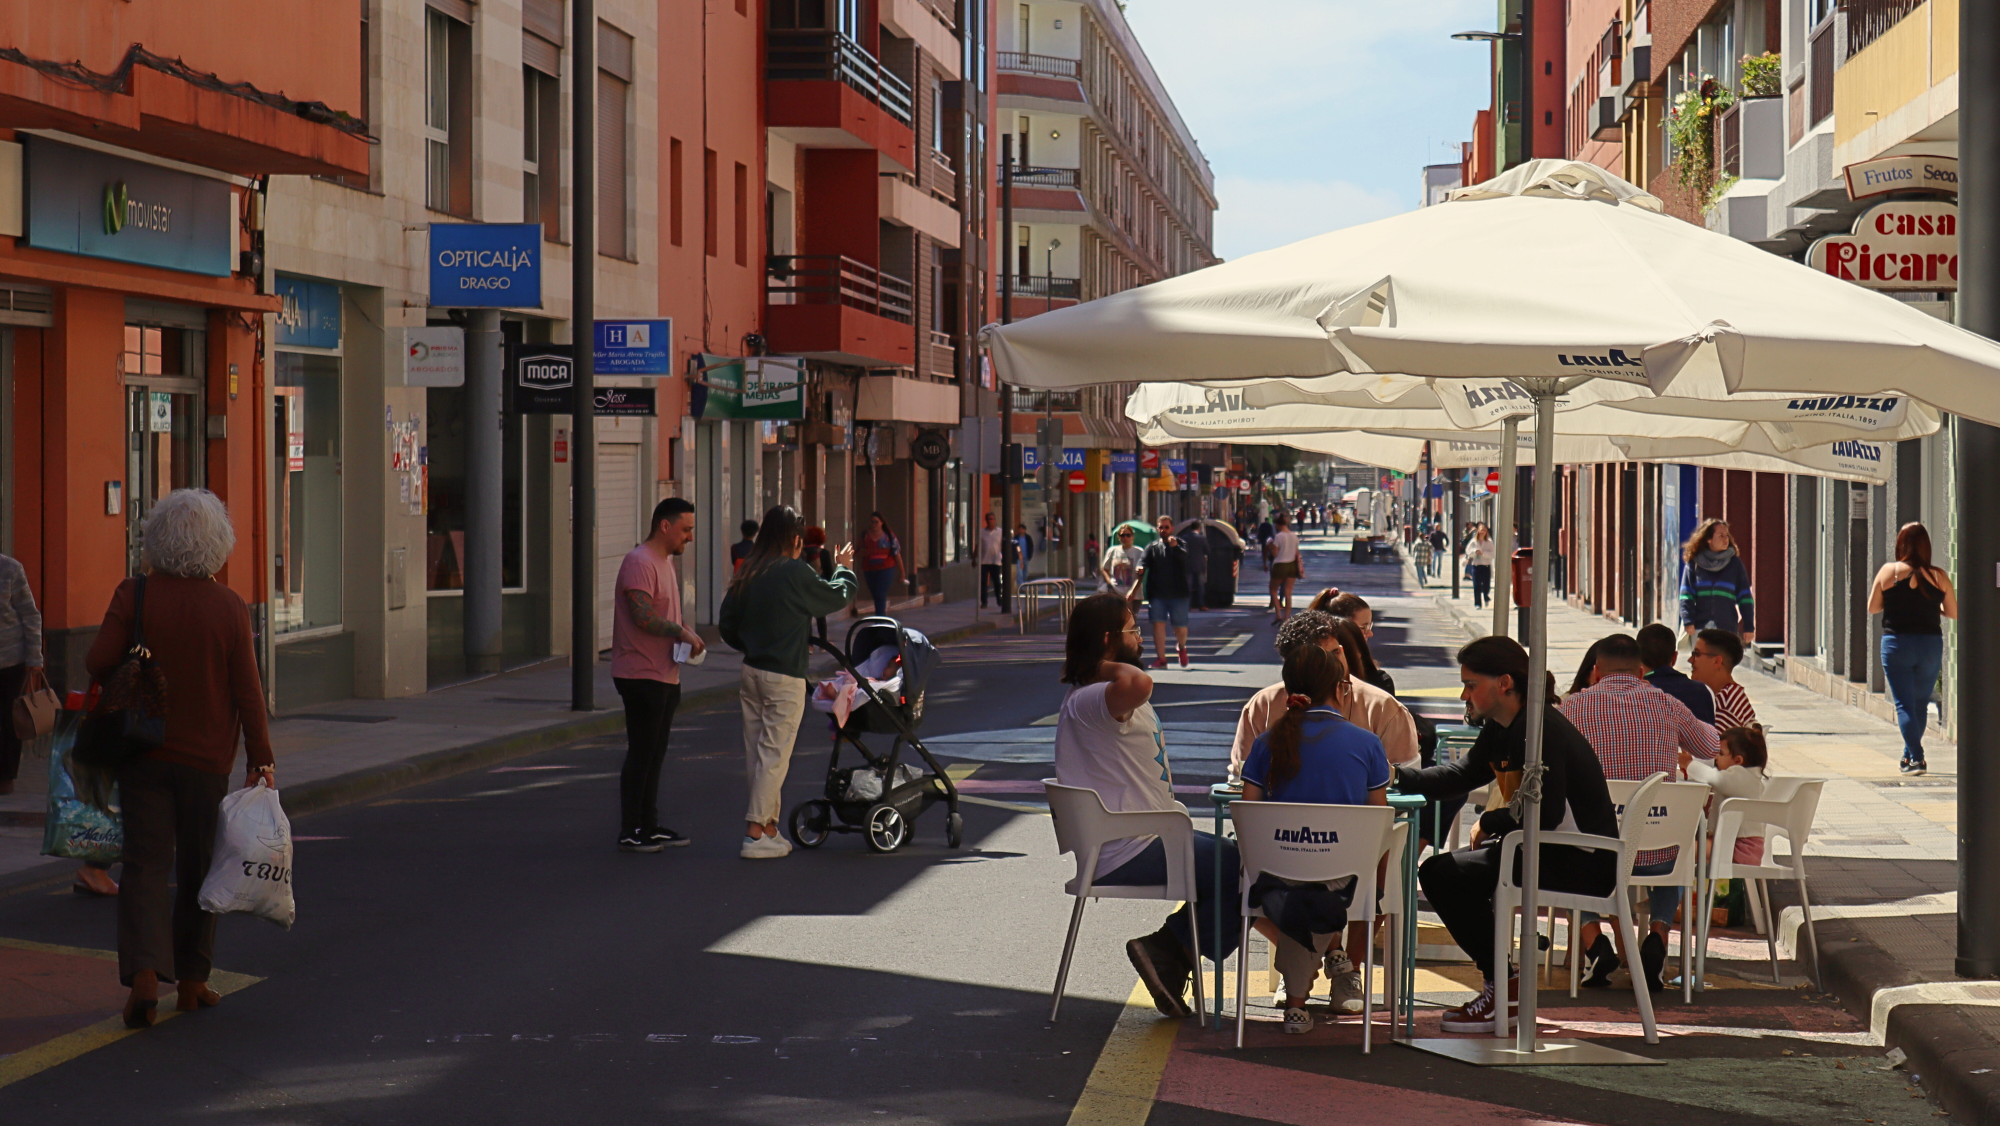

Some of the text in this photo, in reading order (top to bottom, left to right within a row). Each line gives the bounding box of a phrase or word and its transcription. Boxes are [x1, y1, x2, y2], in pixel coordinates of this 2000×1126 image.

[1864, 164, 1958, 186] Frutos Seco
[127, 200, 172, 233] movistar
[460, 277, 510, 289] DRAGO
[610, 330, 644, 343] H A
[527, 365, 567, 379] MOCA
[593, 389, 627, 408] Jess
[1787, 396, 1898, 413] LAVAZZA
[1858, 416, 1877, 426] 1895
[923, 445, 940, 454] MB
[1832, 440, 1881, 462] LAVAZZA
[1025, 451, 1083, 466] GXIA
[1274, 827, 1339, 844] LAVAZZA
[69, 839, 120, 851] SALMON
[242, 860, 292, 884] TRUC
